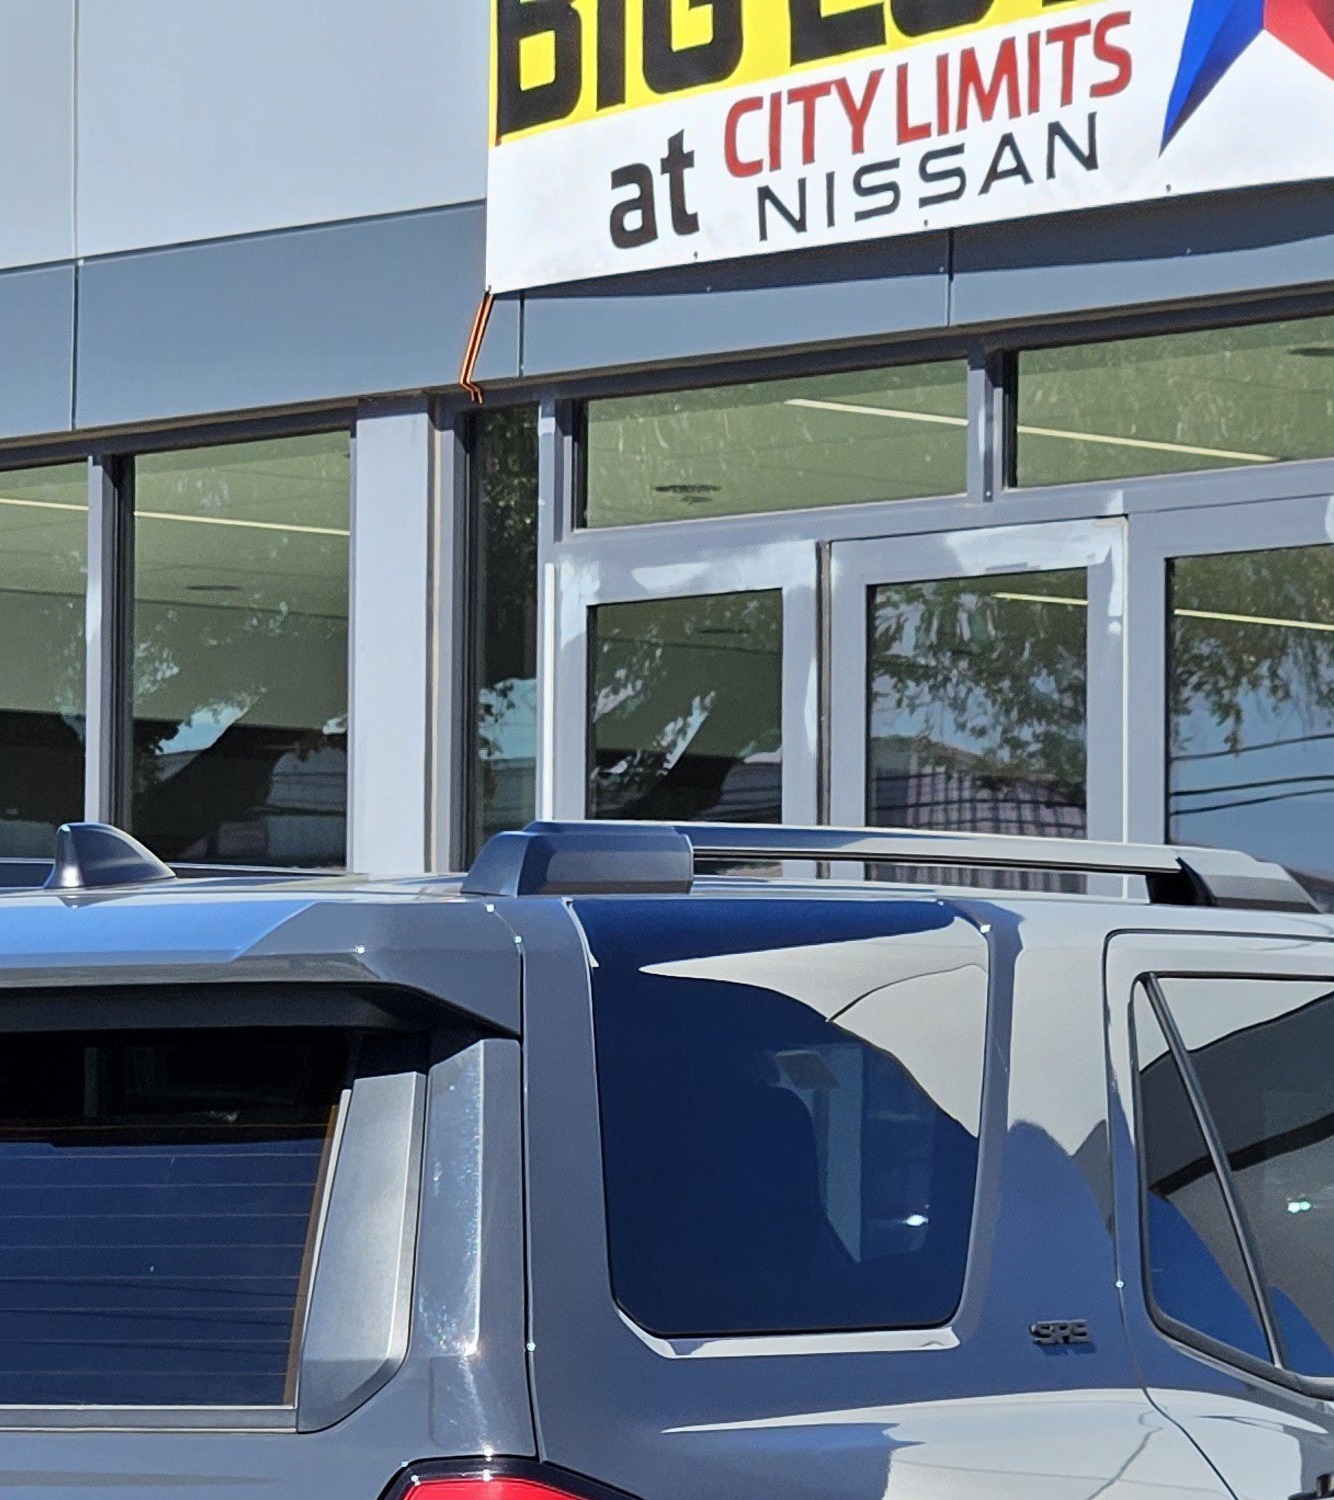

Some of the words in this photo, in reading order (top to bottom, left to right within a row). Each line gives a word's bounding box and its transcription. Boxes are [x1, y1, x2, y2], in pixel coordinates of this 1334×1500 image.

[724, 67, 885, 178] CITY
[896, 10, 1132, 146] LIMITS
[610, 128, 700, 249] at
[758, 110, 1100, 242] NISSAN
